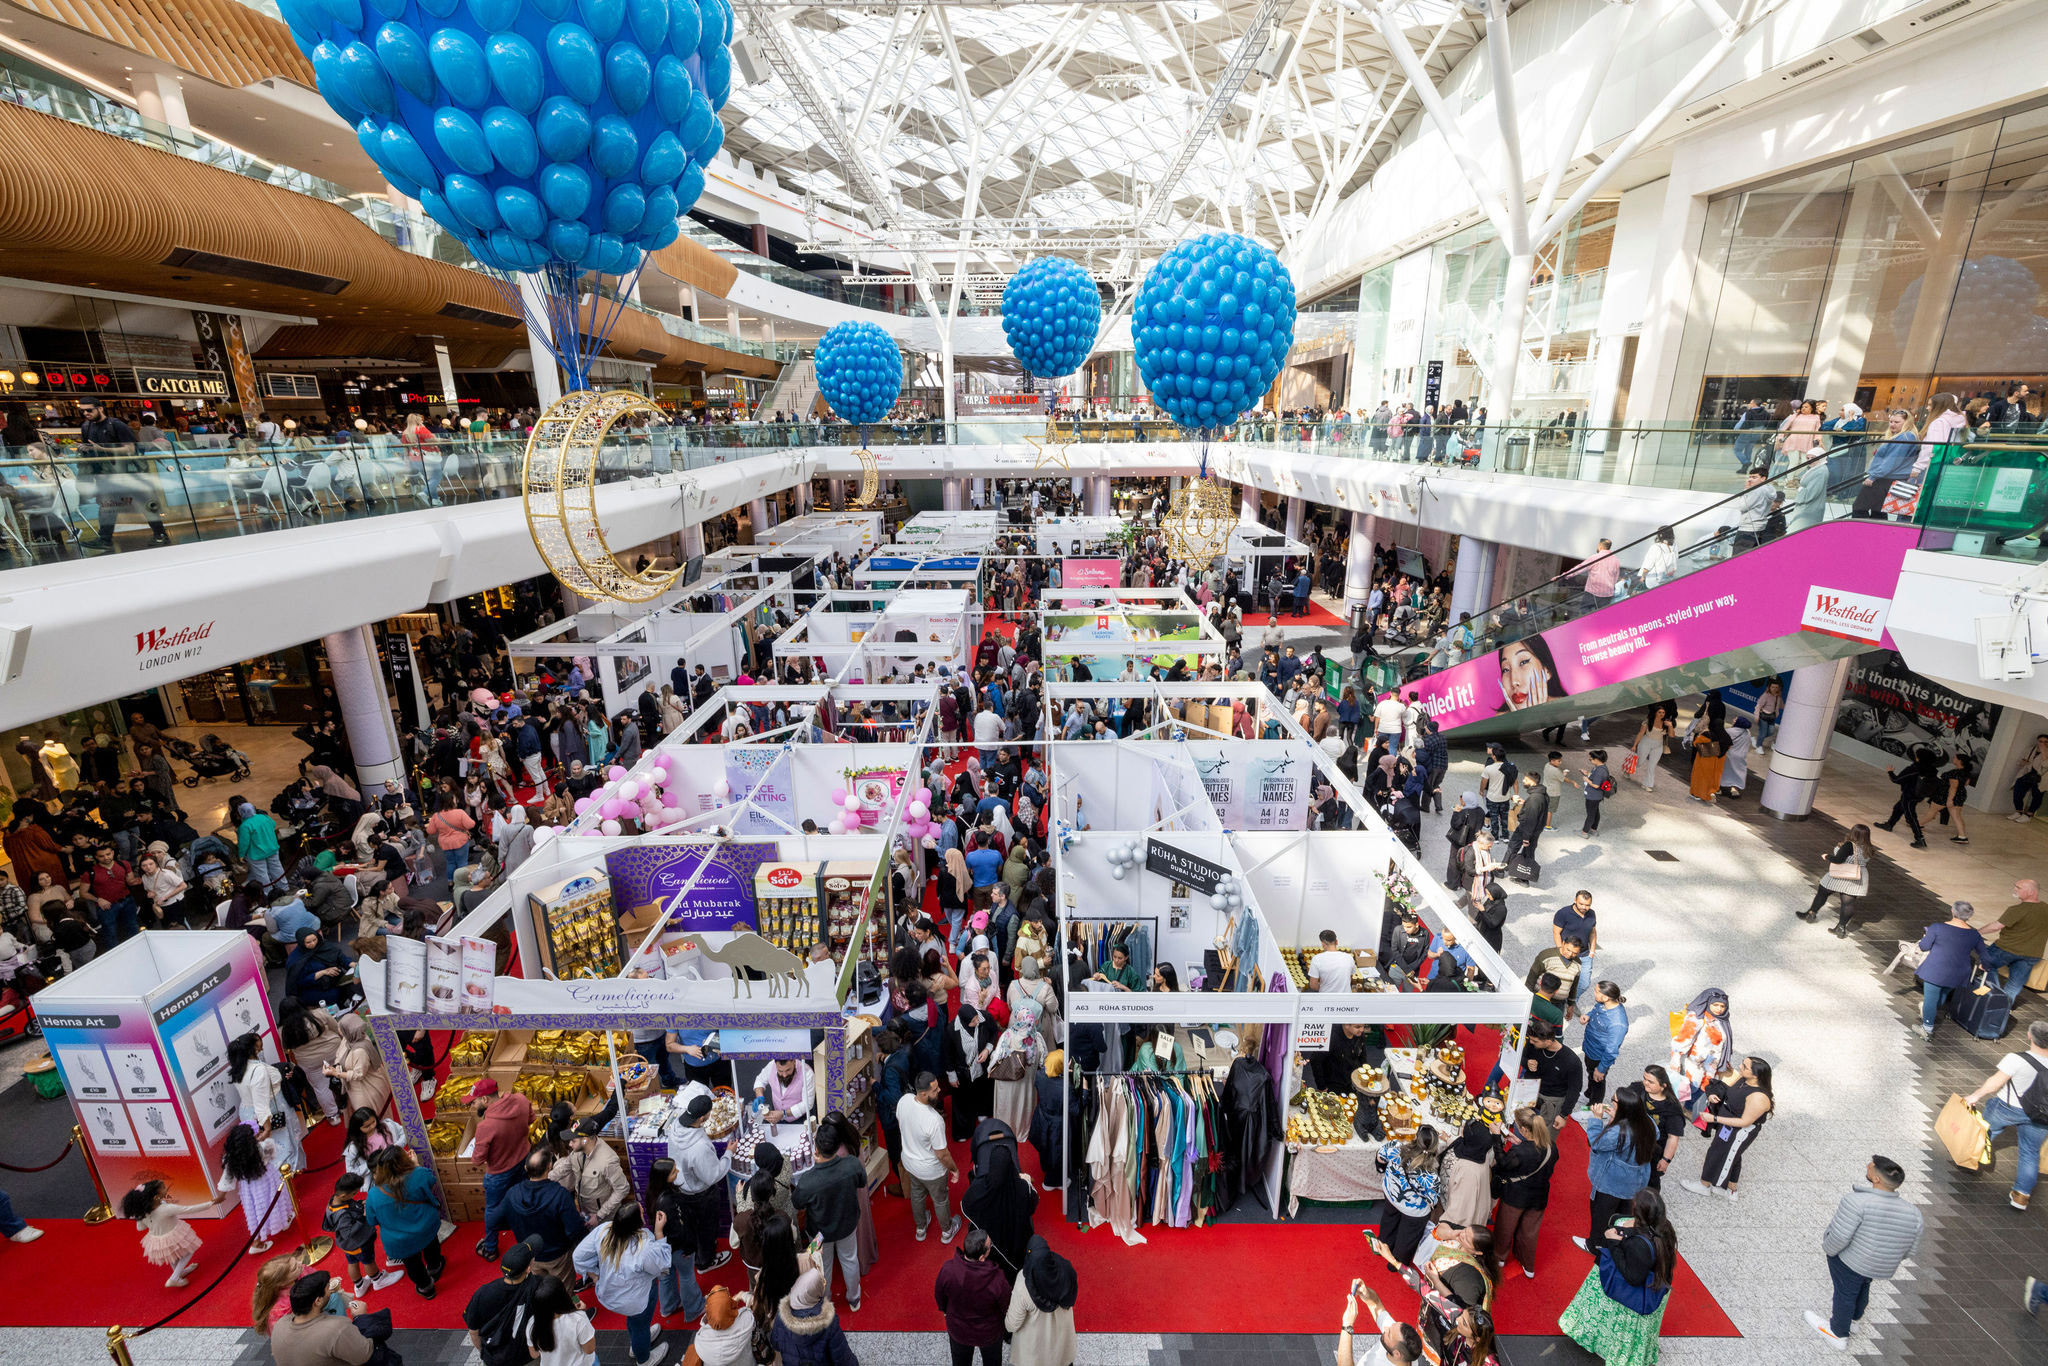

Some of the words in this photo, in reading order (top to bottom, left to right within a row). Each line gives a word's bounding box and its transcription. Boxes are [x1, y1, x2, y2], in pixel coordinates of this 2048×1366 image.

[1428, 367, 1434, 375] 2
[146, 378, 201, 393] CATCH
[203, 380, 225, 394] ME
[964, 396, 989, 404] TAPAS
[989, 395, 1039, 404] REVOLUTION
[1815, 594, 1880, 624] Westfield
[1578, 640, 1598, 653] From
[1598, 628, 1628, 648] neutrals
[1628, 626, 1638, 637] to
[1638, 618, 1666, 634] neons,
[1665, 605, 1693, 625] styled
[1693, 600, 1714, 618] your
[1714, 593, 1738, 609] way.
[134, 620, 216, 656] Westfield
[400, 643, 407, 652] 8
[1581, 652, 1608, 666] Browse
[1608, 641, 1634, 659] beauty
[1634, 635, 1651, 650] IRL.
[139, 652, 181, 671] LONDON
[184, 646, 202, 658] W12
[1869, 670, 1900, 691] that
[1900, 681, 1930, 701] hits
[1932, 692, 1973, 713] your
[1422, 687, 1456, 718] ailed
[1455, 683, 1475, 708] it!
[1869, 690, 1900, 707] with
[1916, 702, 1960, 729] bang
[1263, 783, 1294, 792] WRITTEN
[735, 793, 787, 802] PANTING
[1208, 792, 1230, 802] MES
[1262, 791, 1294, 802] NAMES
[1260, 808, 1271, 817] A4
[1279, 808, 1290, 817] A3
[1151, 845, 1178, 864] RŪHA
[1180, 857, 1220, 881] STUDIO
[1170, 864, 1189, 876] DUBAI
[770, 875, 799, 886] Sofra
[693, 899, 741, 908] Mubarak
[681, 908, 713, 920] مبارك
[714, 909, 735, 918] عيد
[160, 990, 199, 1020] Henna
[201, 975, 220, 993] Art
[566, 984, 675, 1003] Camelicious
[43, 1017, 83, 1027] Henna
[85, 1018, 106, 1027] Art
